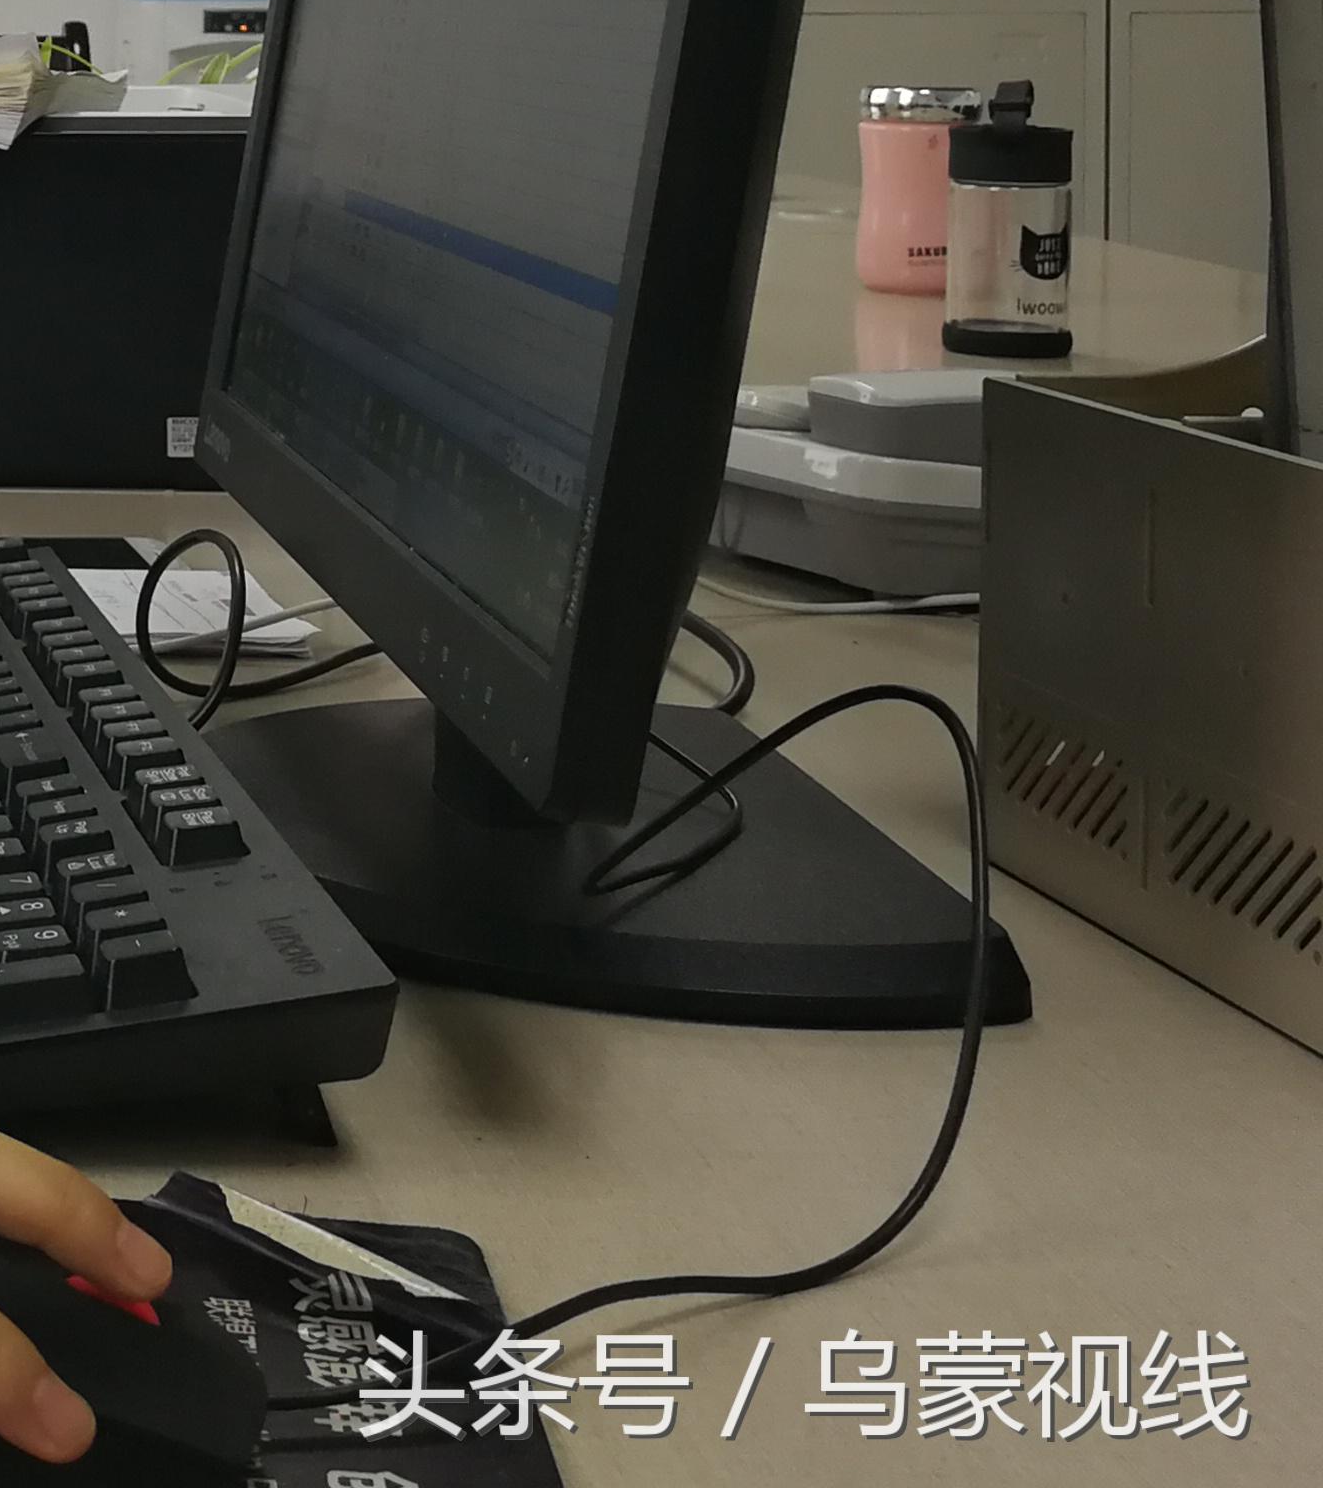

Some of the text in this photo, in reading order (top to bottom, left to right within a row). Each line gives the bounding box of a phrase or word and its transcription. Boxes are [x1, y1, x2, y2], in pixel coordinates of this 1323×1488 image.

[9, 875, 33, 885] 7
[20, 901, 44, 912] 8
[34, 929, 59, 940] 9
[256, 914, 325, 977] Lenovo
